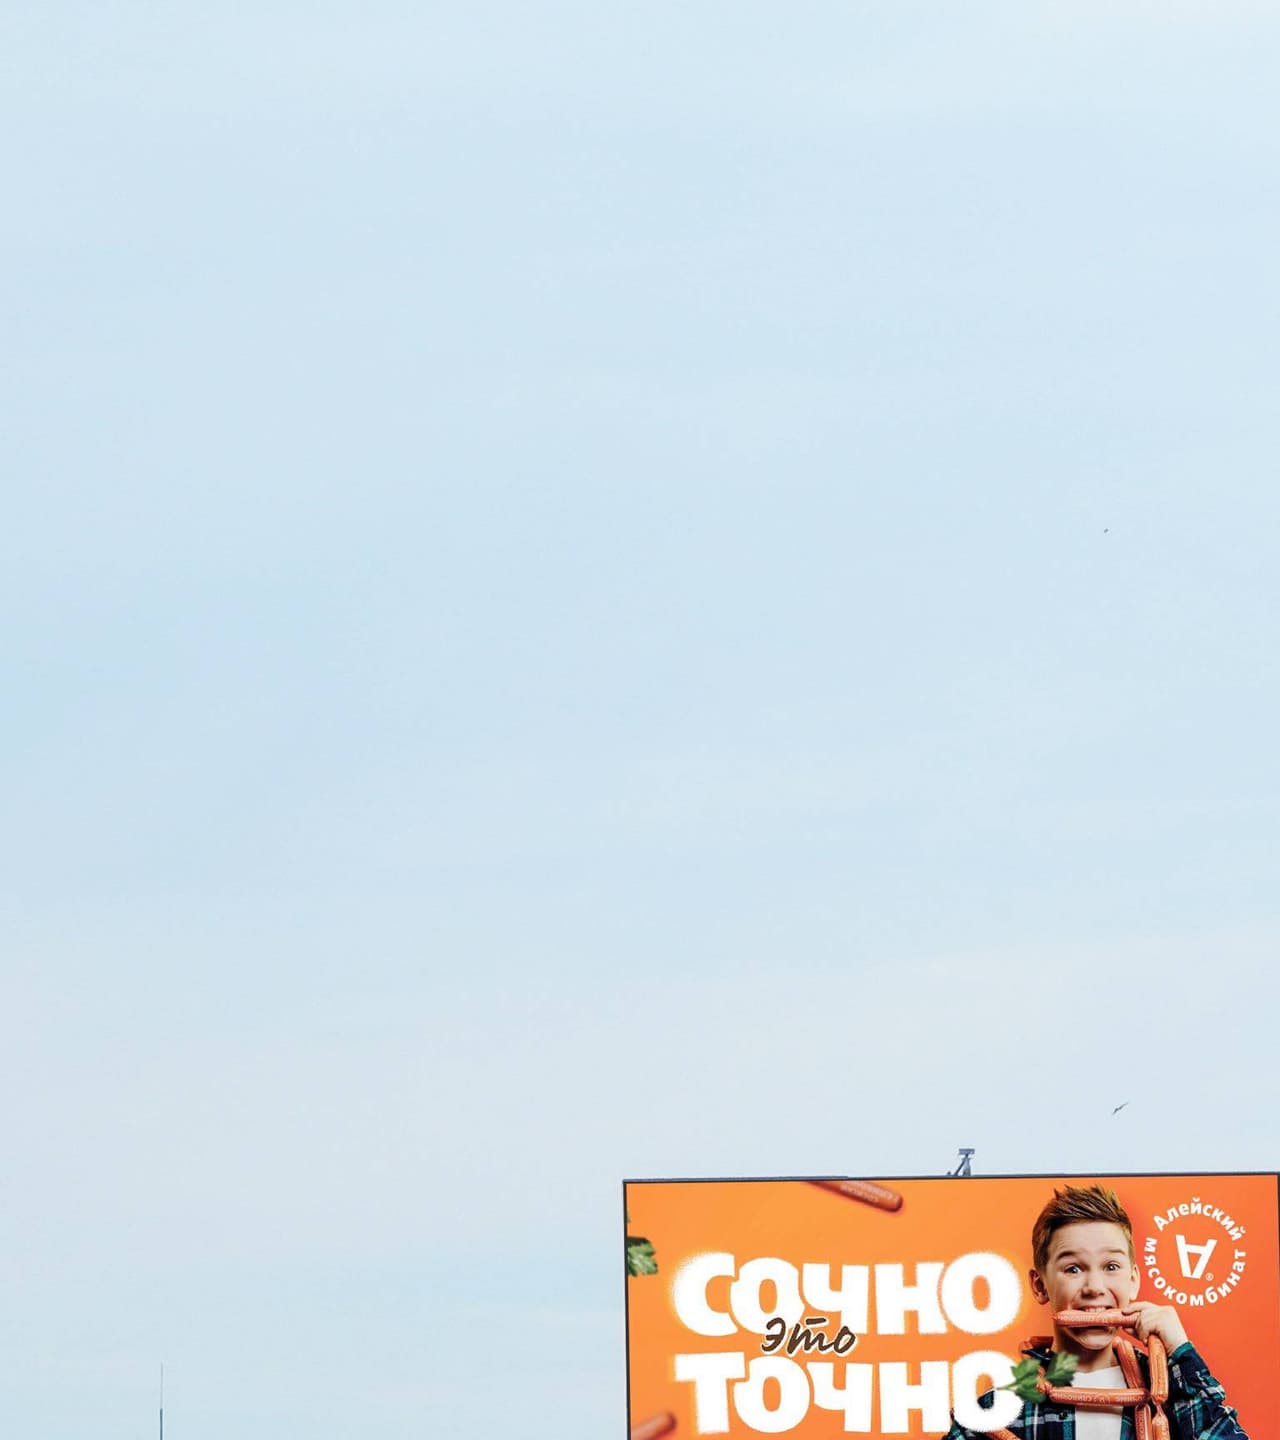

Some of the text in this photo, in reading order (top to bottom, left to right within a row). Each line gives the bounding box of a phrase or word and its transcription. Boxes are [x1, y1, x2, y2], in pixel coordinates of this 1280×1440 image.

[1153, 1197, 1246, 1241] Алейский
[672, 1251, 1022, 1336] СОЧНО
[1144, 1237, 1246, 1307] мясокомбинат
[673, 1350, 1023, 1435] ТОЧНО
